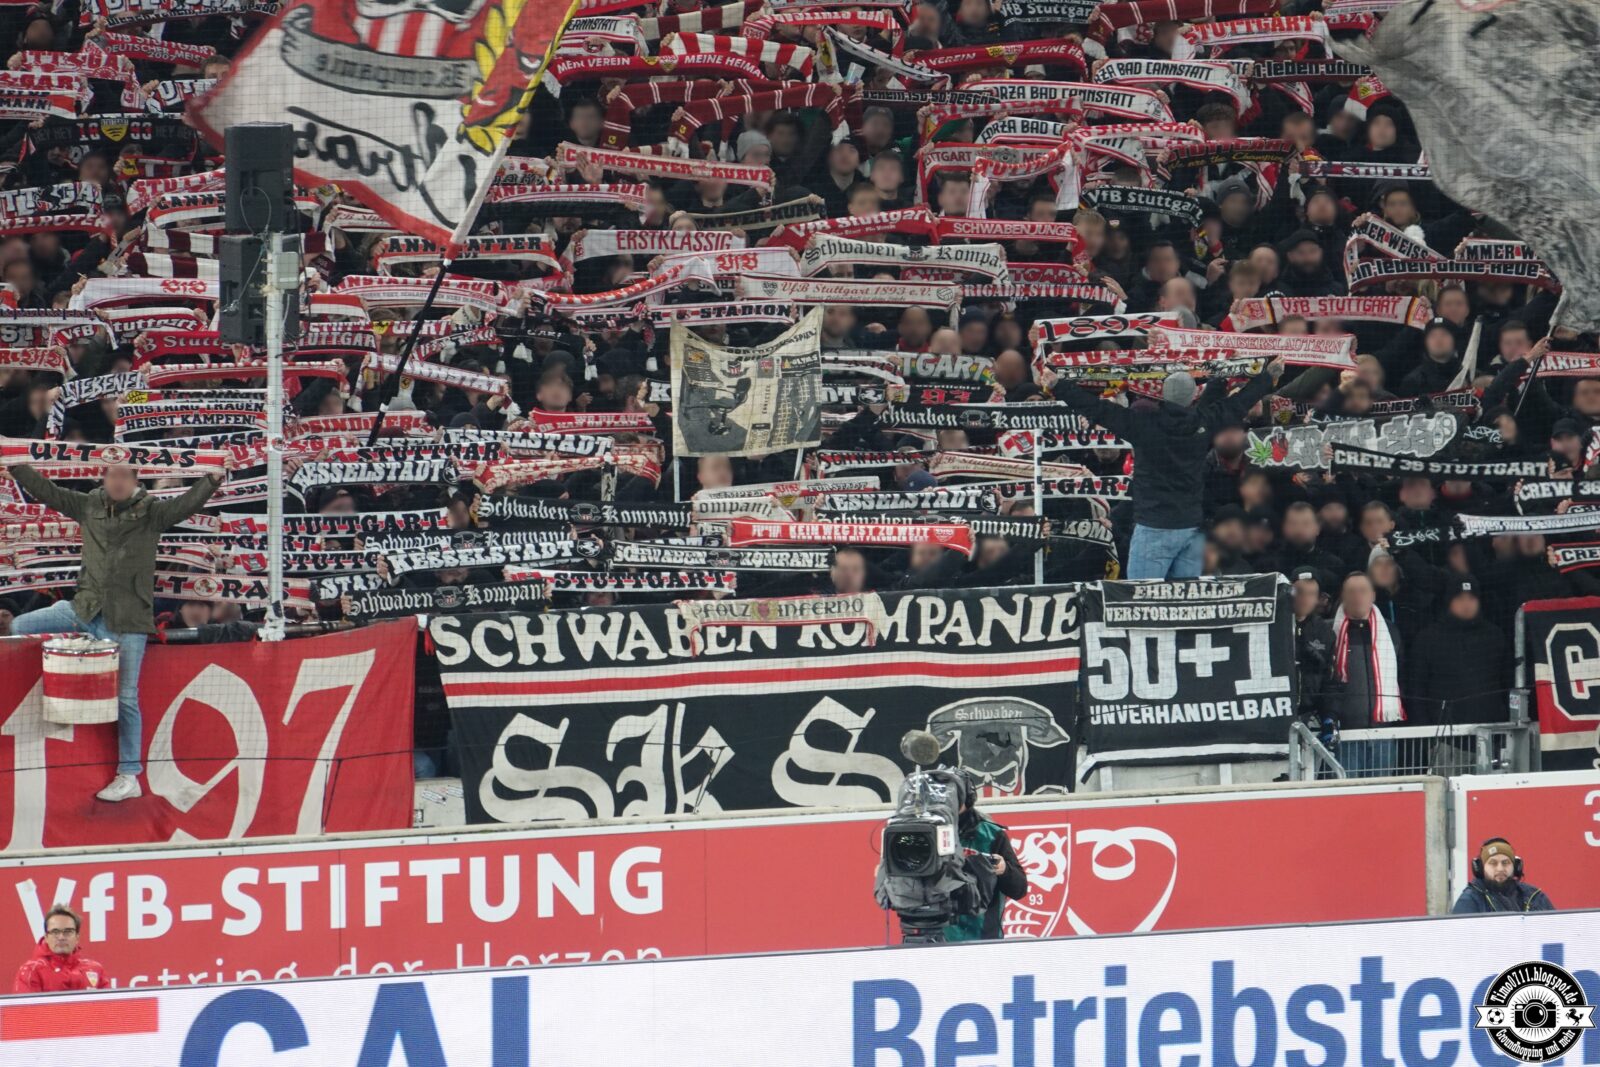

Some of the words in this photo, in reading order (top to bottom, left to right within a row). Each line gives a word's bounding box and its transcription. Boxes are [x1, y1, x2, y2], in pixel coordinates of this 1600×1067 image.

[1001, 3, 1023, 18] VfB
[1027, 4, 1093, 18] Stuttgar
[1184, 16, 1313, 45] STUTTGART
[105, 43, 170, 55] DEUTSCHER
[174, 49, 209, 66] MEIST
[588, 56, 632, 69] VEREIN
[684, 53, 723, 66] MEINE
[929, 51, 978, 67] VEREIN
[1028, 43, 1066, 55] MEINE
[1118, 61, 1143, 76] BAD
[1145, 61, 1214, 82] CANNSTATT
[1030, 85, 1060, 101] BAD
[1062, 87, 1136, 108] CANNSTATT
[982, 118, 1017, 142] FORZA
[1020, 119, 1049, 135] BAD
[565, 147, 694, 178] CNNSTATTER
[711, 166, 771, 184] KURVE
[1088, 190, 1123, 204] VfB
[1128, 191, 1205, 221] Stuttgart
[790, 220, 832, 238] VfB
[836, 208, 933, 229] Stuttgart
[616, 230, 734, 252] ERSTKLASSIG
[1459, 244, 1516, 260] MMER
[804, 240, 897, 265] Schwaben
[935, 246, 1002, 270] Kompa
[779, 281, 808, 294] VfB
[813, 282, 870, 297] Stuttgart
[873, 284, 906, 296] 1893
[699, 303, 793, 320] STADION
[1319, 296, 1401, 313] STUTTGART
[60, 325, 95, 341] VfB
[113, 317, 199, 333] tuttgart
[1038, 313, 1162, 343] 1893
[1212, 334, 1346, 355] KAISERSLAUTERN
[125, 414, 177, 431] HEISST
[128, 446, 198, 468] RAS
[358, 441, 503, 462] STUTTGAR
[1333, 449, 1396, 470] CREW
[1428, 461, 1549, 478] STUTTGART
[291, 458, 446, 493] KESSELSTADT
[822, 489, 983, 511] KESSELSTADT
[1519, 480, 1574, 502] CREW
[478, 494, 570, 522] Schwaben
[698, 499, 773, 521] ompani
[283, 510, 442, 536] TUTTGART
[789, 524, 823, 536] KEIN
[823, 524, 852, 536] WEG
[853, 525, 878, 536] IST
[878, 525, 895, 536] ZU
[895, 525, 930, 537] WEIT
[385, 540, 575, 577] KESSELSTADT
[612, 545, 708, 566] SCHWABEN
[739, 550, 830, 570] KOMPANIE
[1561, 549, 1600, 562] CRE
[222, 578, 289, 602] RA
[552, 571, 728, 591] STUTTGART
[1132, 582, 1188, 600] EHRE
[1188, 580, 1247, 599] ALLEN
[346, 583, 435, 618] Schwaben
[1105, 605, 1217, 623] VERSTORBENEN
[1218, 602, 1274, 619] ULTRAS
[429, 606, 778, 668] SCHWABEN
[1084, 622, 1292, 703] 50+1
[954, 707, 1023, 724] Schwaben
[1089, 696, 1293, 727] UNVERHANDELBAR
[15, 846, 664, 944] VfB-STIFTUNG
[1028, 893, 1044, 906] 93
